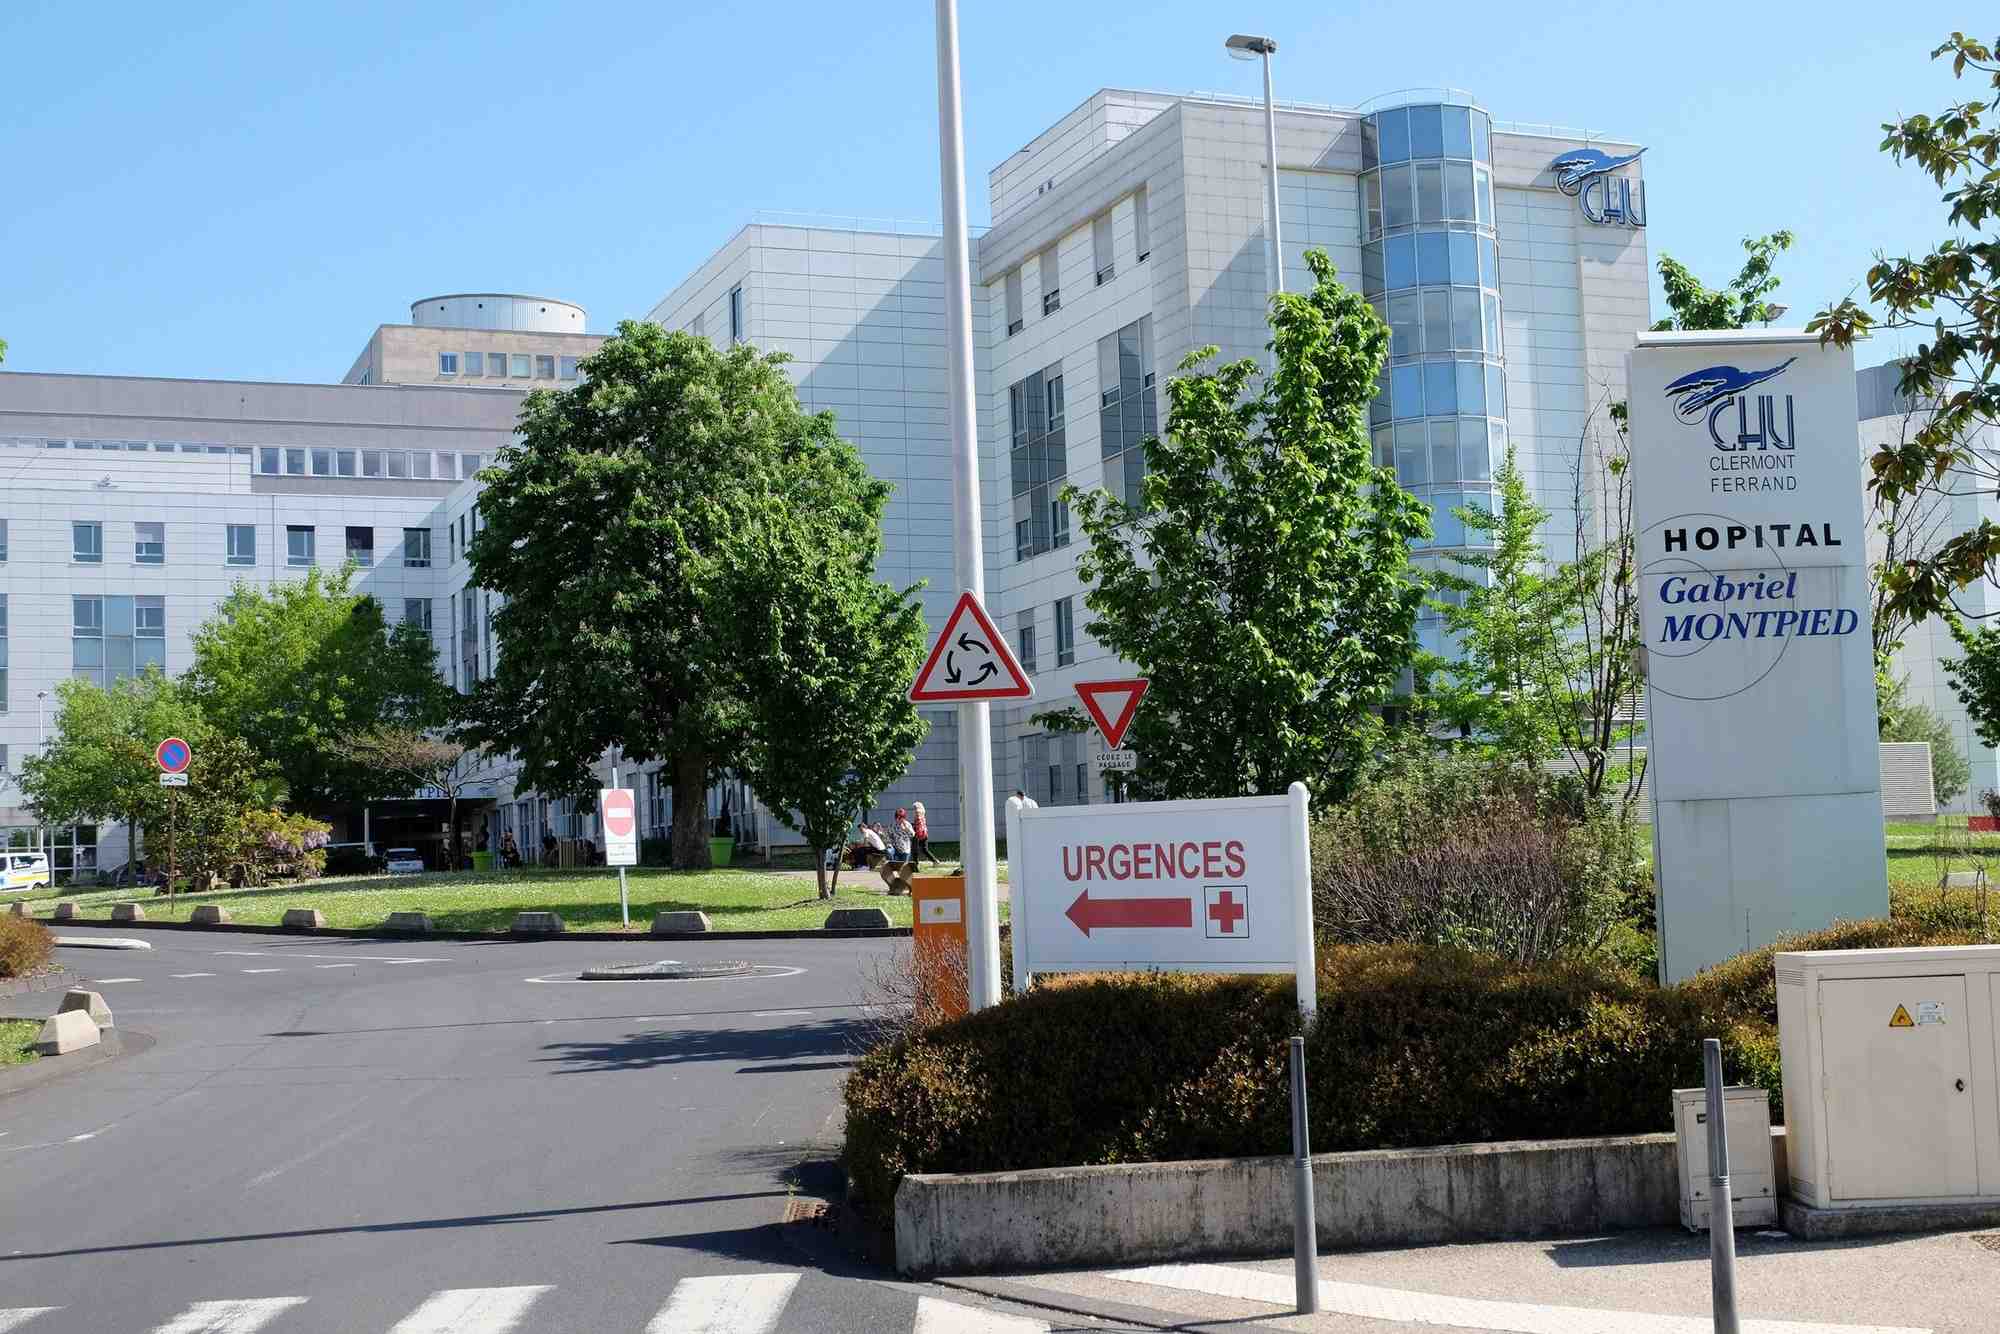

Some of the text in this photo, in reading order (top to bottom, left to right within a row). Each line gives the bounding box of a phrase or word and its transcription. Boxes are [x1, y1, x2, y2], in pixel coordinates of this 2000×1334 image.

[1580, 175, 1647, 227] CHU
[1708, 395, 1795, 451] CHU
[1709, 454, 1795, 471] CLERMONT
[1711, 475, 1797, 493] FERRAND
[1663, 523, 1842, 552] HOPITAL
[1660, 572, 1798, 604] Gabriel
[1659, 608, 1858, 642] MONTPIED
[1062, 840, 1246, 881] URGENCES
